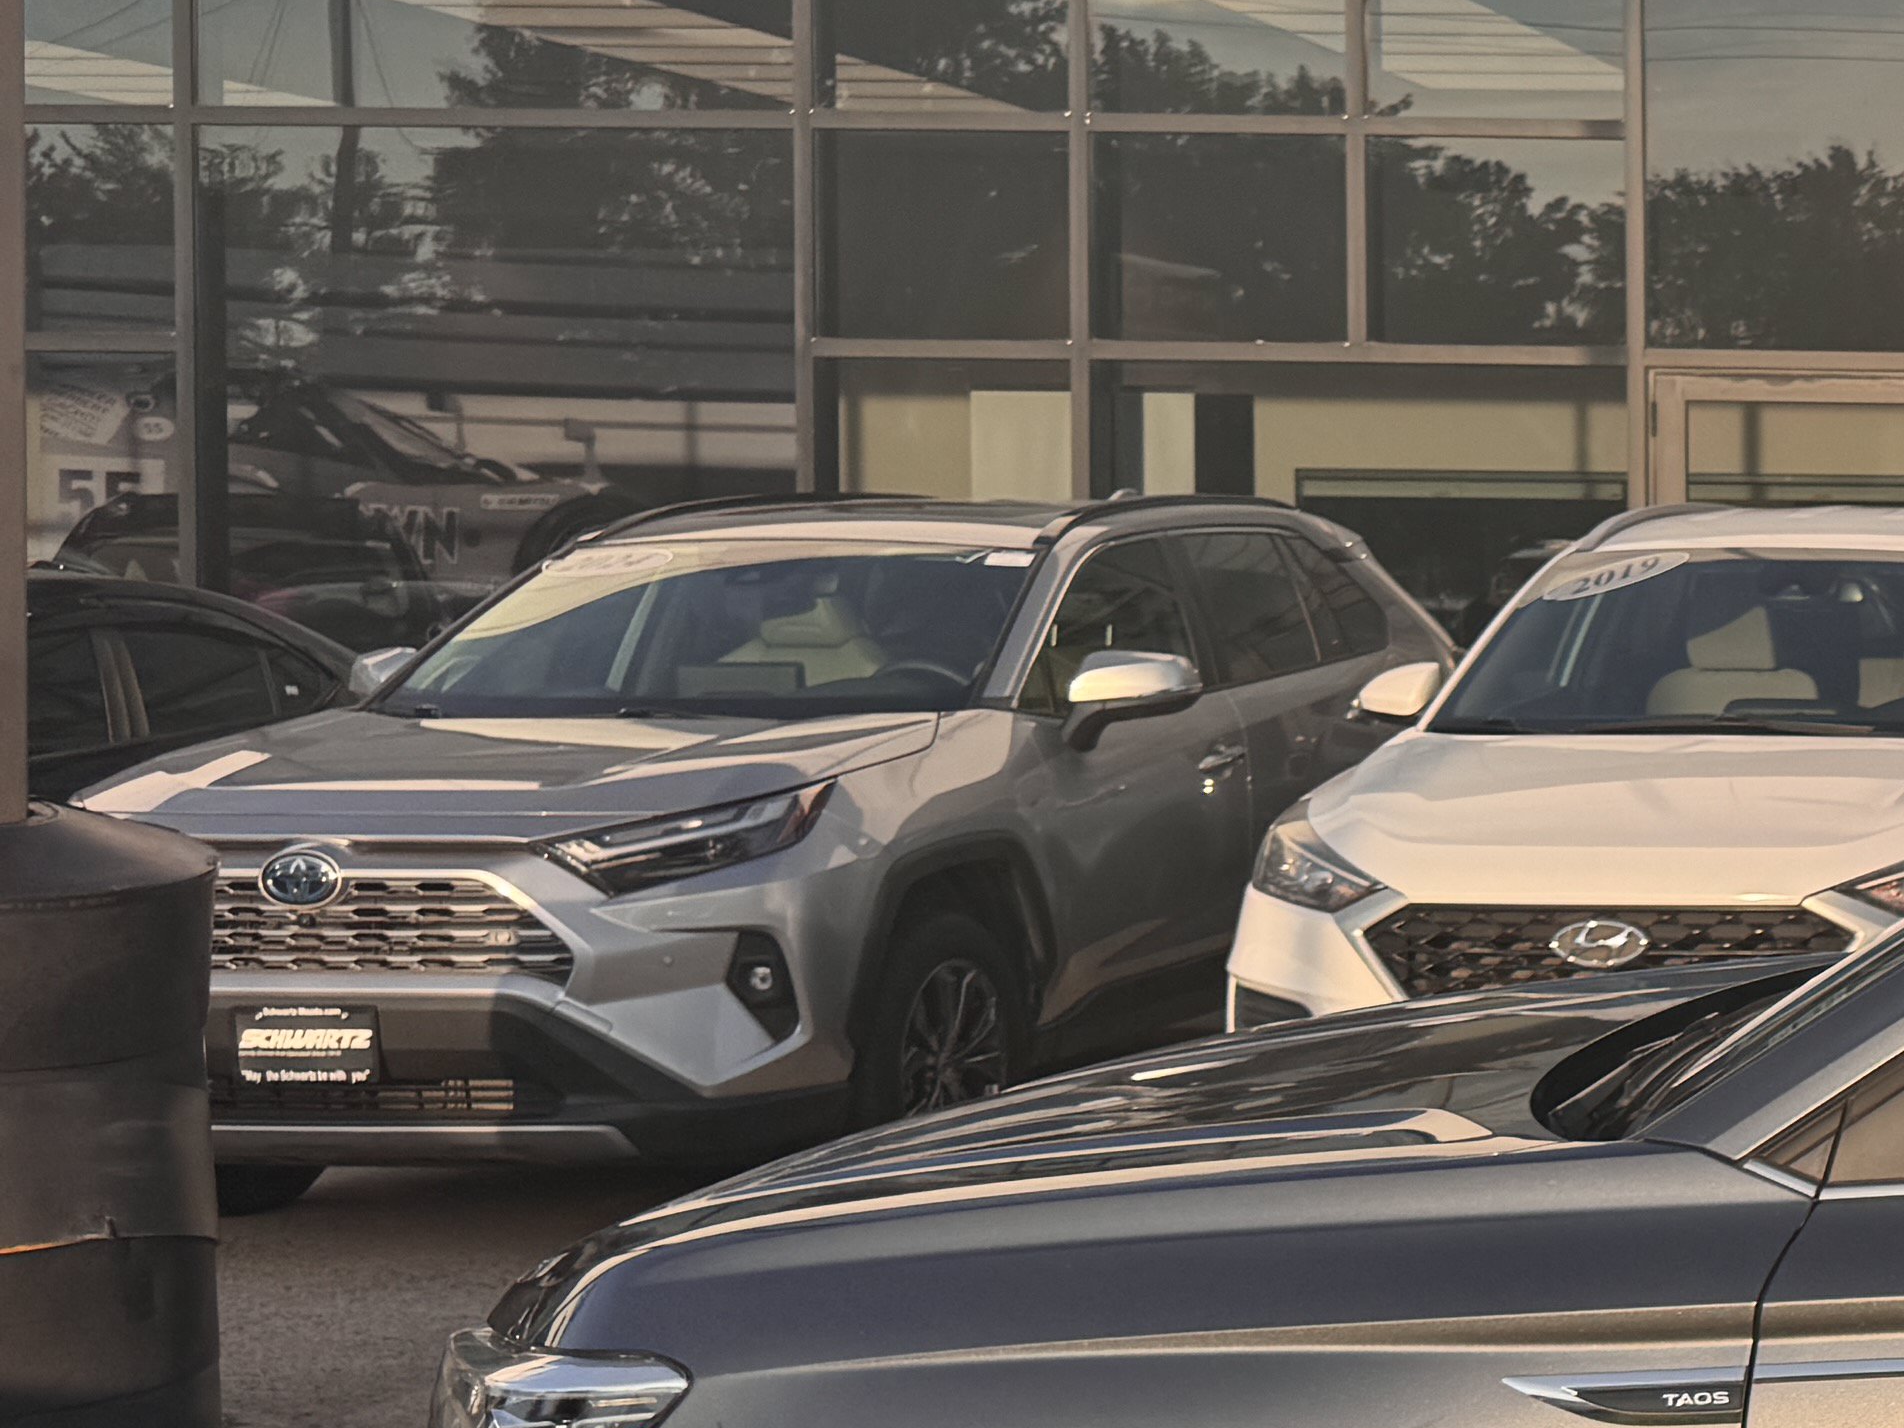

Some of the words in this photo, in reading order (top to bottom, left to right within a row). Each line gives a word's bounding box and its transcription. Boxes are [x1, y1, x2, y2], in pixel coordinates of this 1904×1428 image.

[1570, 556, 1661, 595] 2019
[238, 1028, 374, 1050] SCHWARTZ
[1662, 1390, 1730, 1408] TAOS
